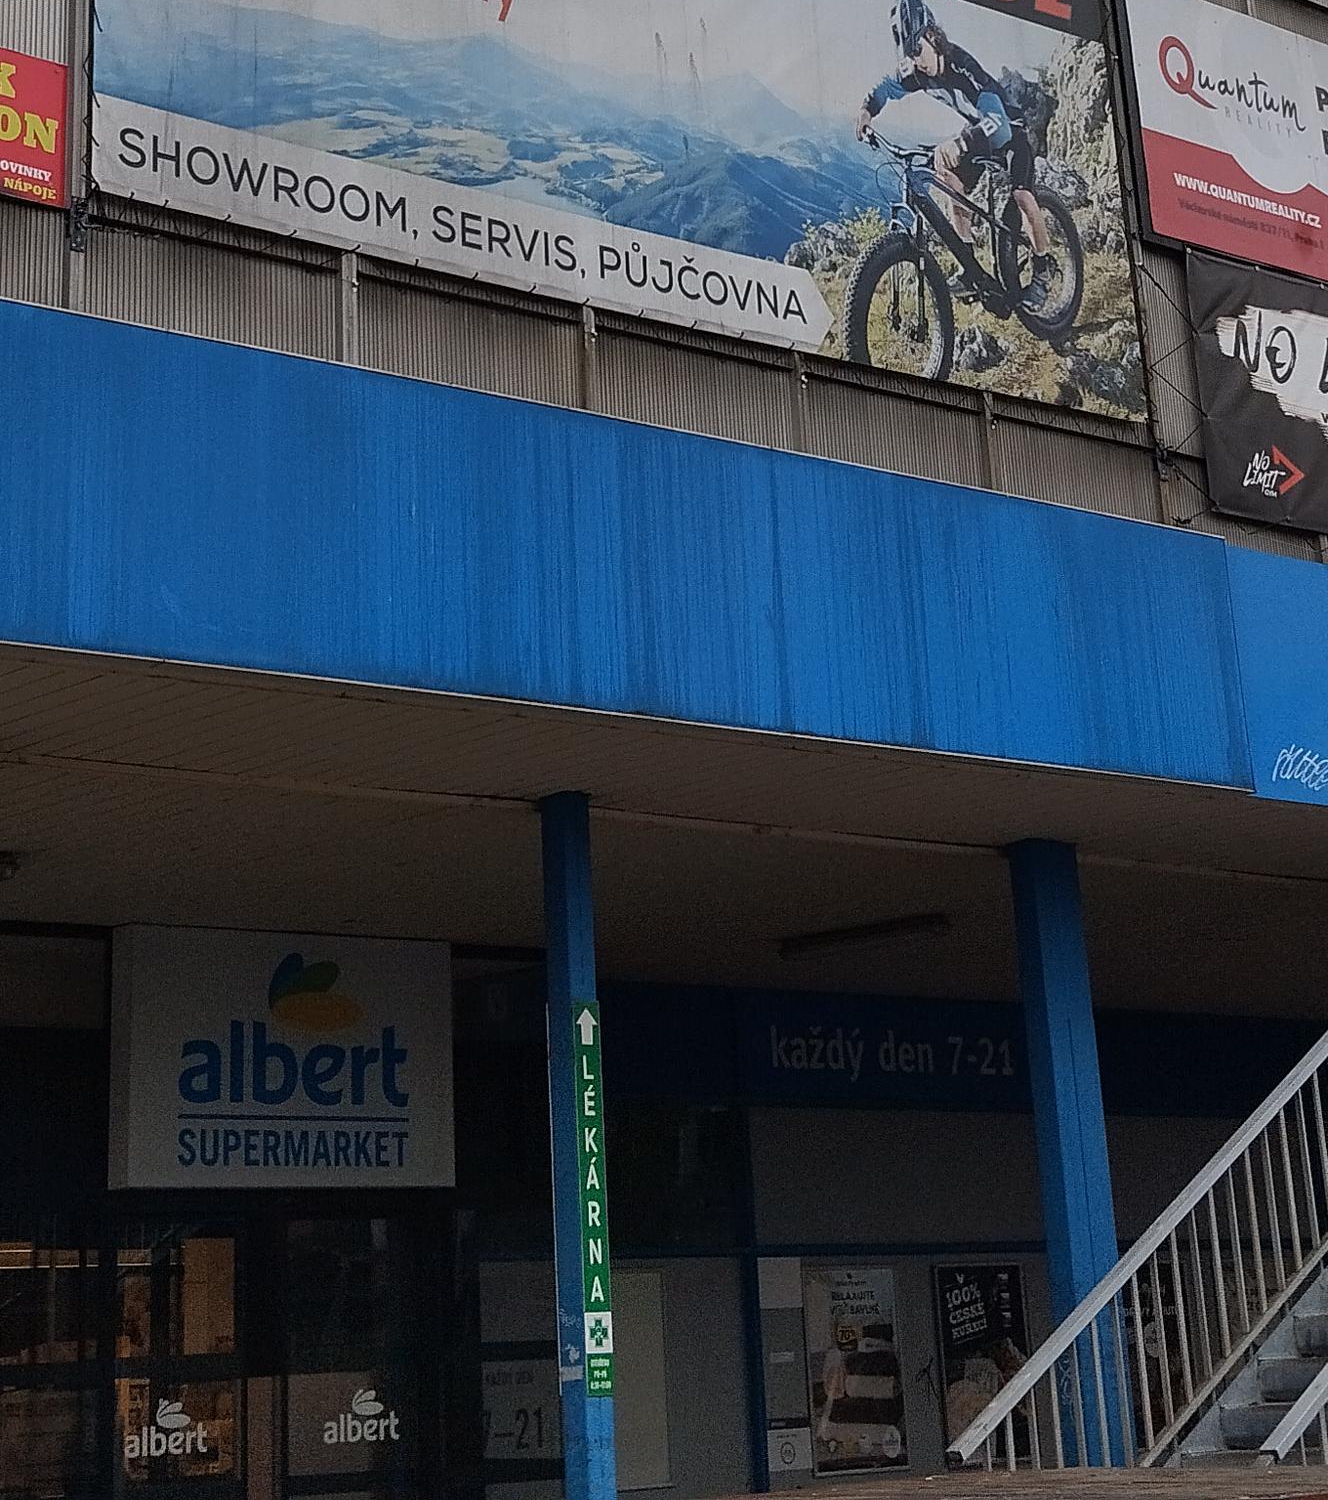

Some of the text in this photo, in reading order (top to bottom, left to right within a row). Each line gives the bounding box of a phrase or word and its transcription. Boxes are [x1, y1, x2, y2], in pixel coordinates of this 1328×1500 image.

[1158, 35, 1306, 131] Quantum
[1224, 106, 1293, 138] REALITY
[4, 177, 57, 200] NÁPOJE
[1173, 172, 1322, 228] WWW.QUANTUMREALITY.CZ
[117, 125, 808, 325] SHOWROOM, SERVIS, PŮJČOVNA
[1234, 310, 1297, 384] NO
[1242, 463, 1286, 492] LIMIT
[177, 1019, 410, 1108] albert
[769, 1025, 1014, 1083] každý den 7-21
[177, 1129, 409, 1168] SUPERMARKET
[581, 1054, 605, 1303] LÉKÁRNA
[124, 1425, 208, 1460] albert
[324, 1412, 400, 1444] albert
